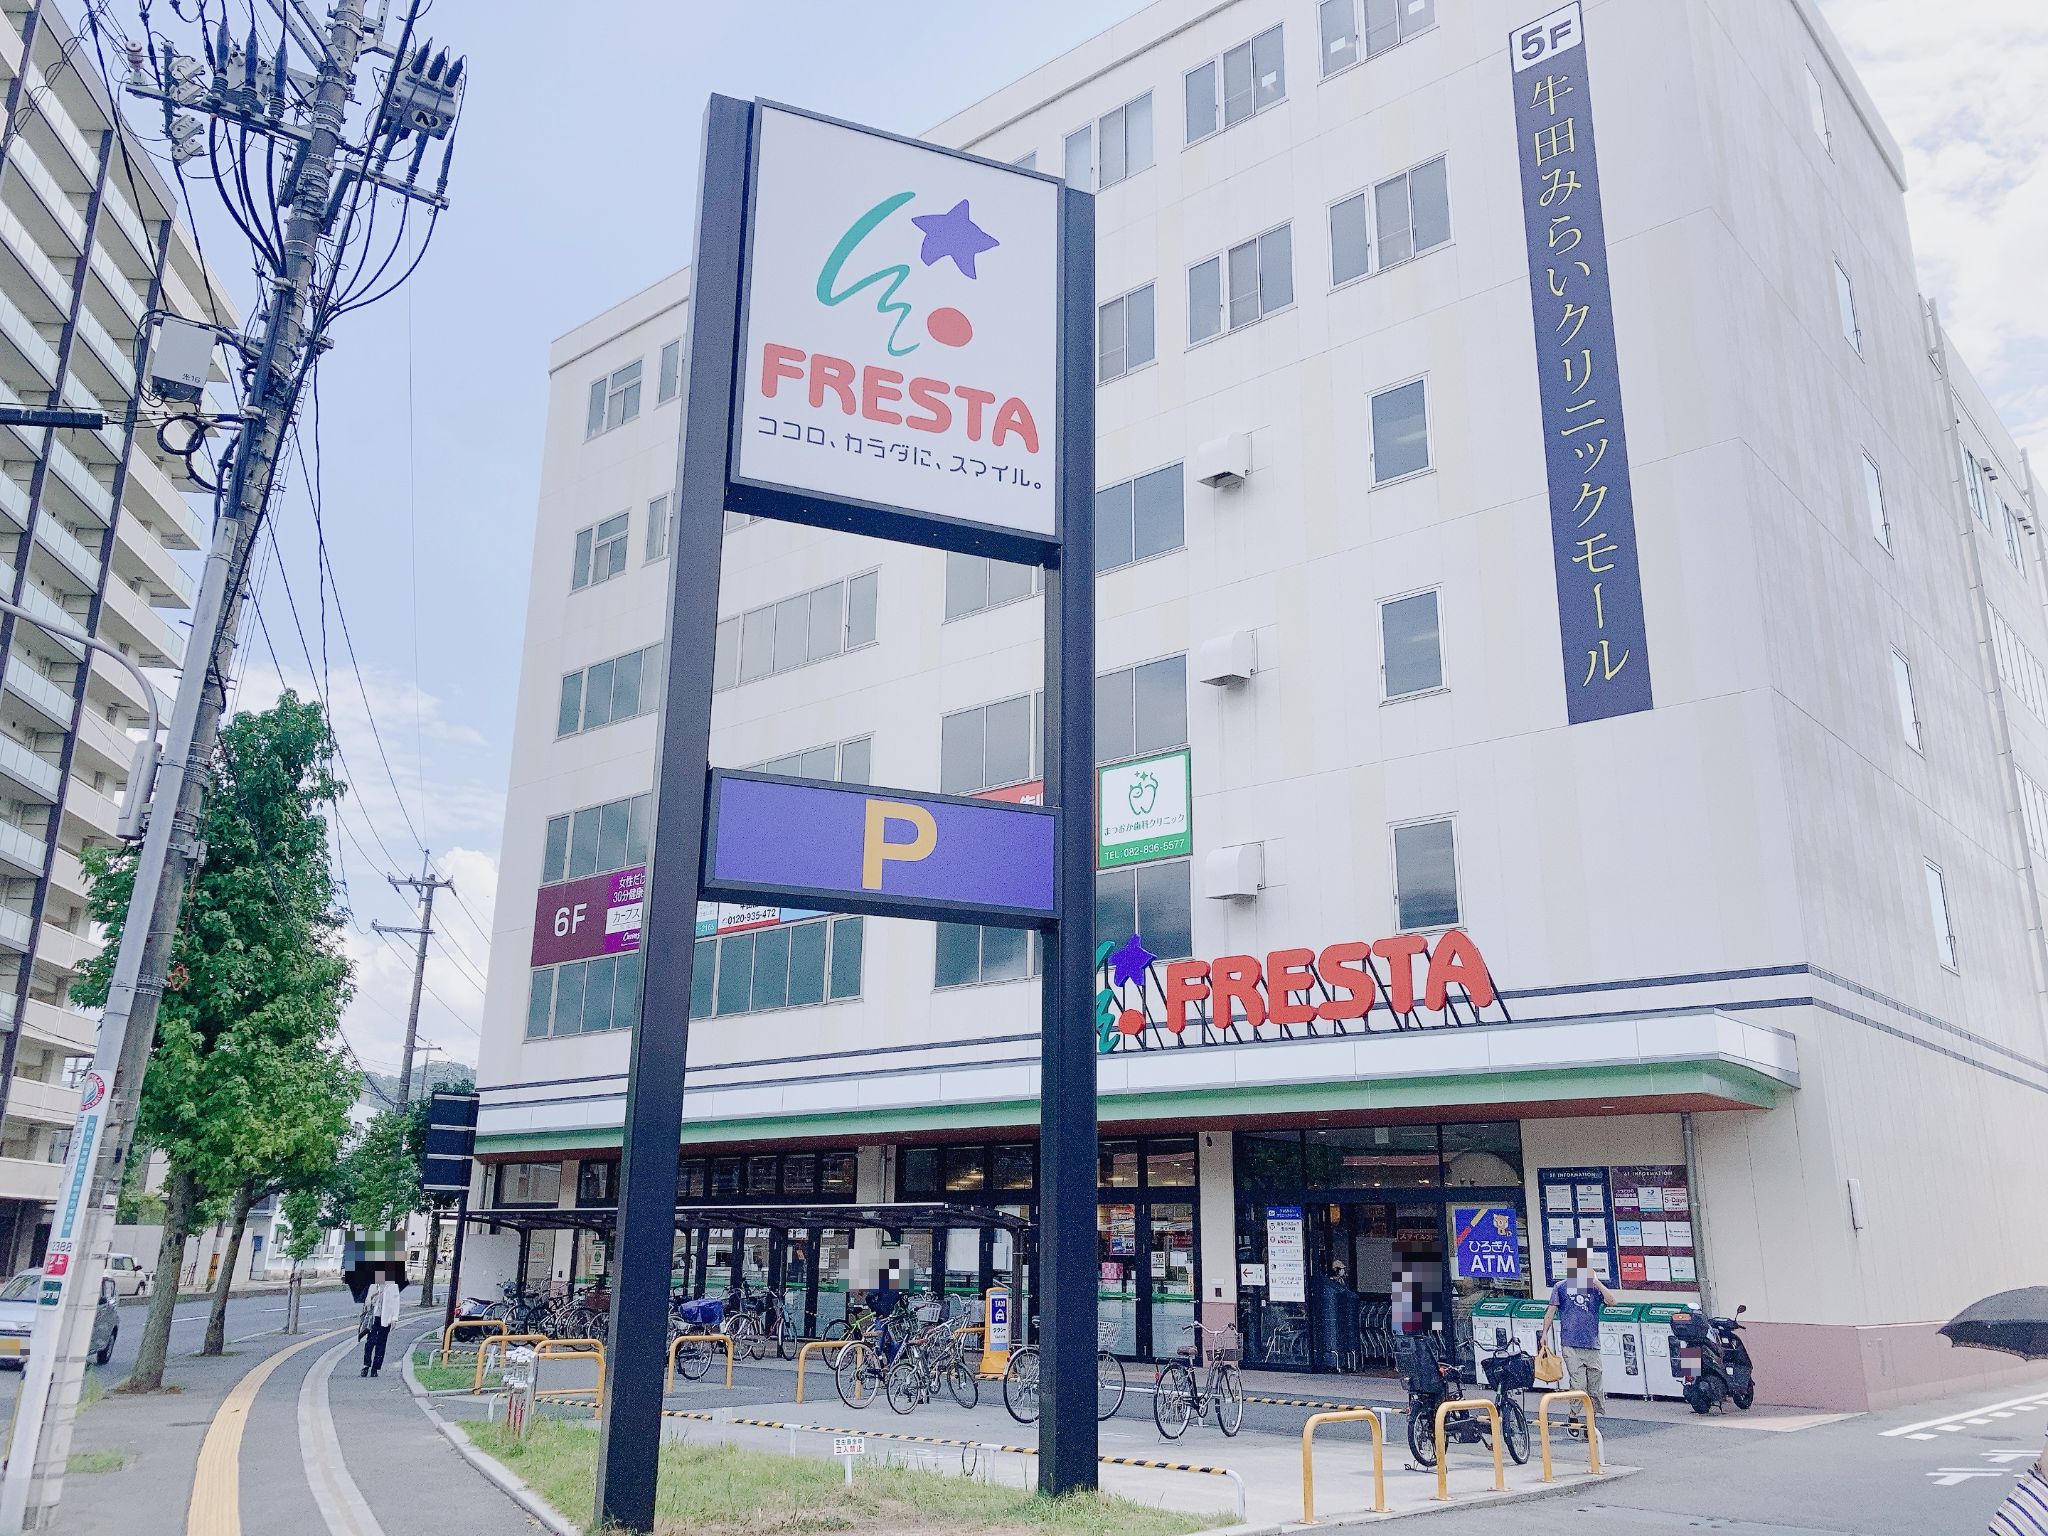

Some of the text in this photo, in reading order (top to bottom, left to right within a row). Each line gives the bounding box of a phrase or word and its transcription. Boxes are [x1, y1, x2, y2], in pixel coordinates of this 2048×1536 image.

[1521, 19, 1573, 61] 5F
[761, 342, 1040, 454] FRESTA
[1529, 74, 1630, 688] 牛田みらいクリニックモール
[758, 415, 1042, 490] ココロ、カラダに、スマイル。
[862, 798, 938, 891] P
[1104, 813, 1185, 836] まつおか歯科クリニック
[554, 902, 588, 938] 6F
[1166, 929, 1494, 1034] FRESTA
[1470, 1254, 1516, 1274] ATM
